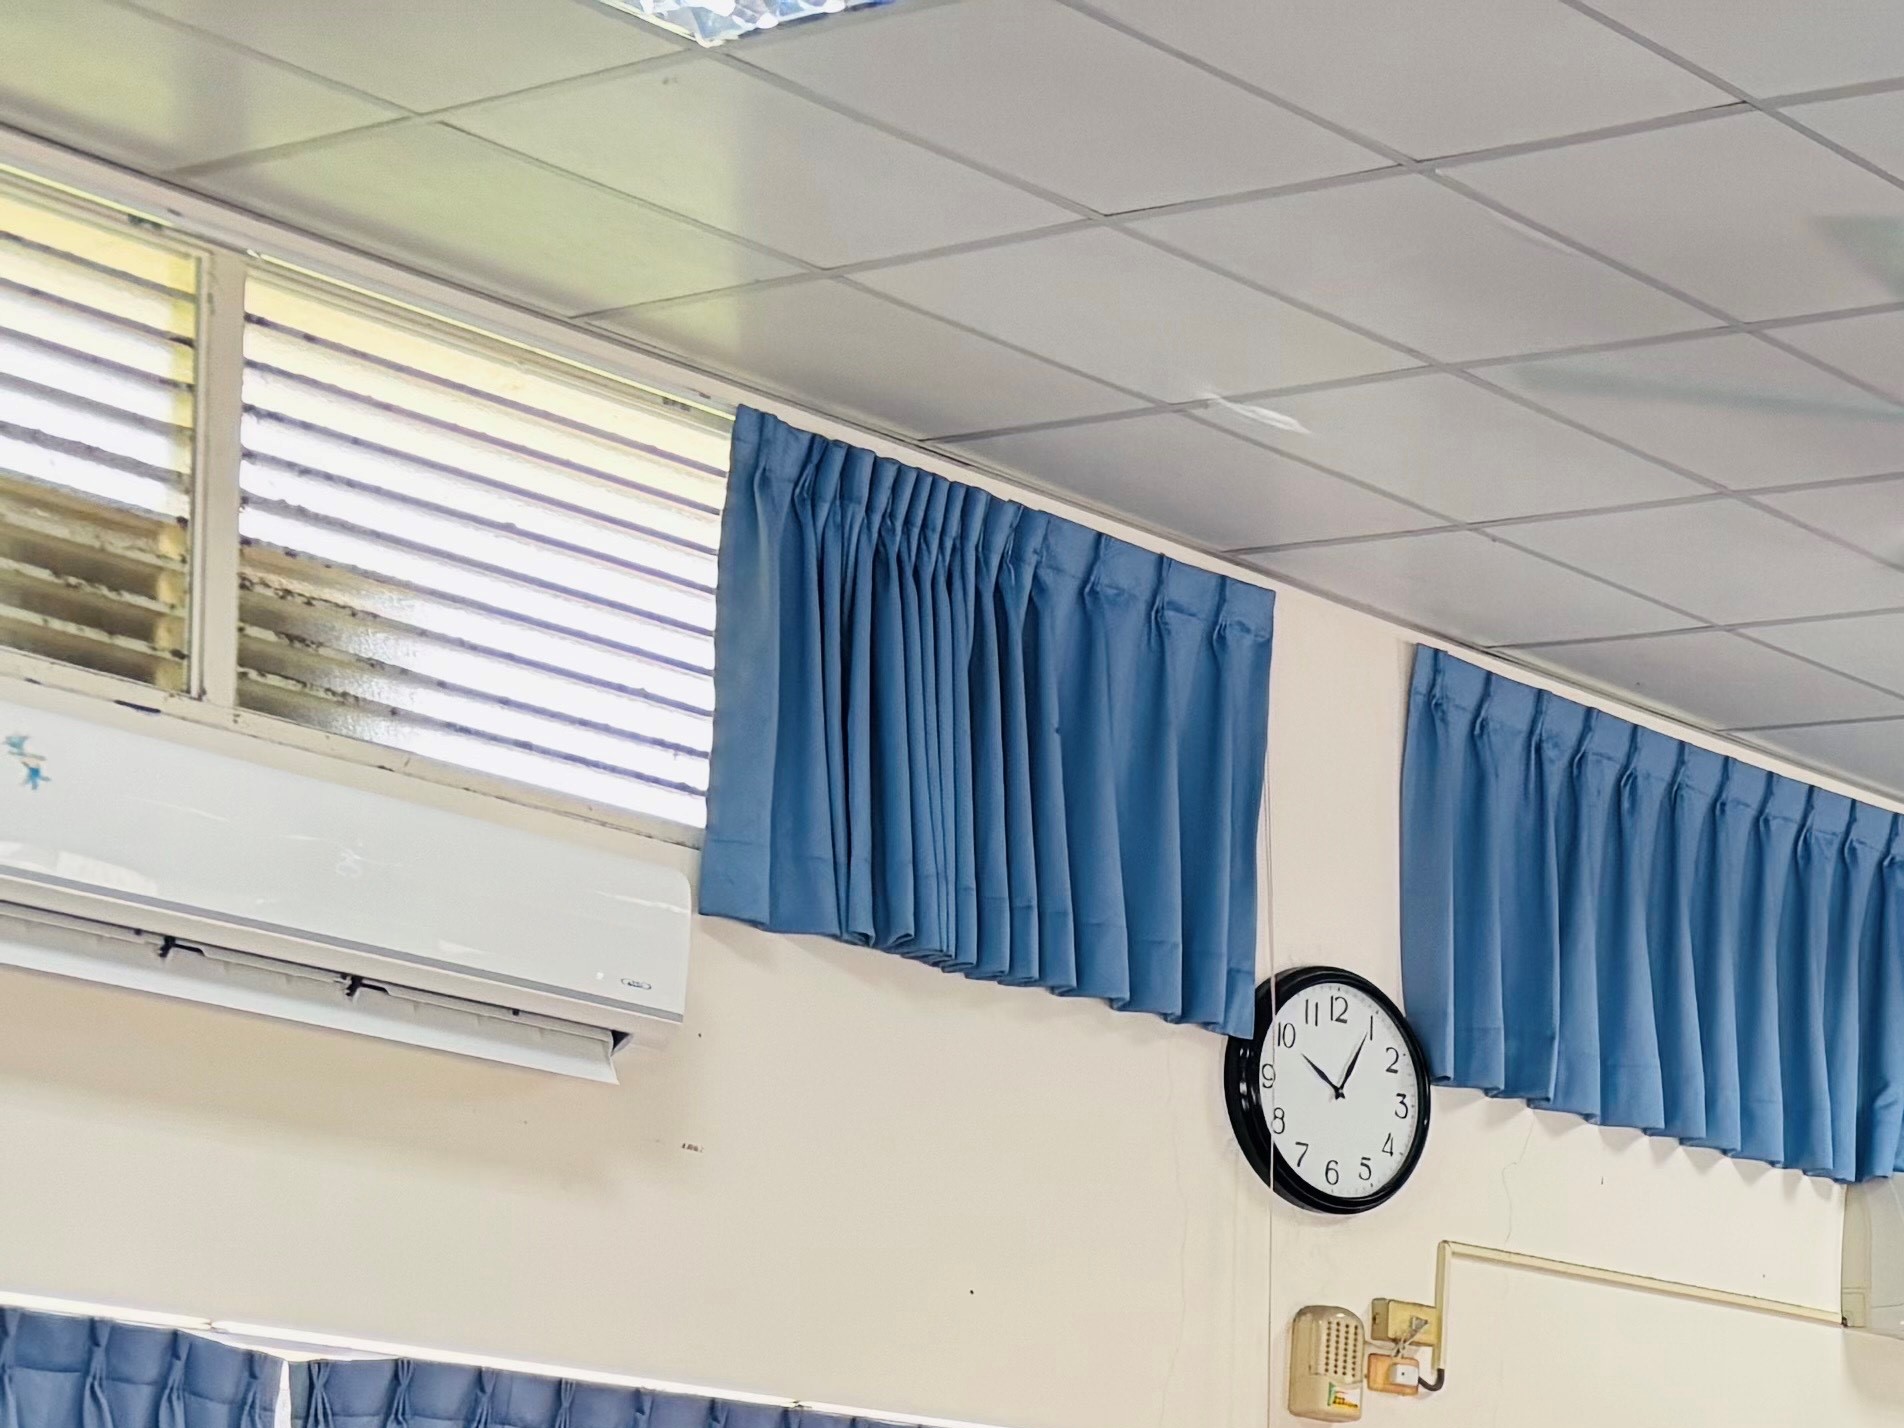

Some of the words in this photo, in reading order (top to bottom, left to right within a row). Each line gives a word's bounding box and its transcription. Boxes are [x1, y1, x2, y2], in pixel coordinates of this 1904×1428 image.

[1305, 999, 1319, 1027] 11
[1329, 995, 1349, 1024] 12
[1277, 1022, 1296, 1049] 10
[1385, 1047, 1400, 1073] 2
[1261, 1063, 1276, 1089] 9
[1394, 1093, 1408, 1119] 3
[1271, 1107, 1285, 1134] 8
[1295, 1141, 1309, 1167] 7
[1381, 1132, 1394, 1157] 4
[1325, 1160, 1339, 1185] 6
[1358, 1156, 1372, 1180] 5
